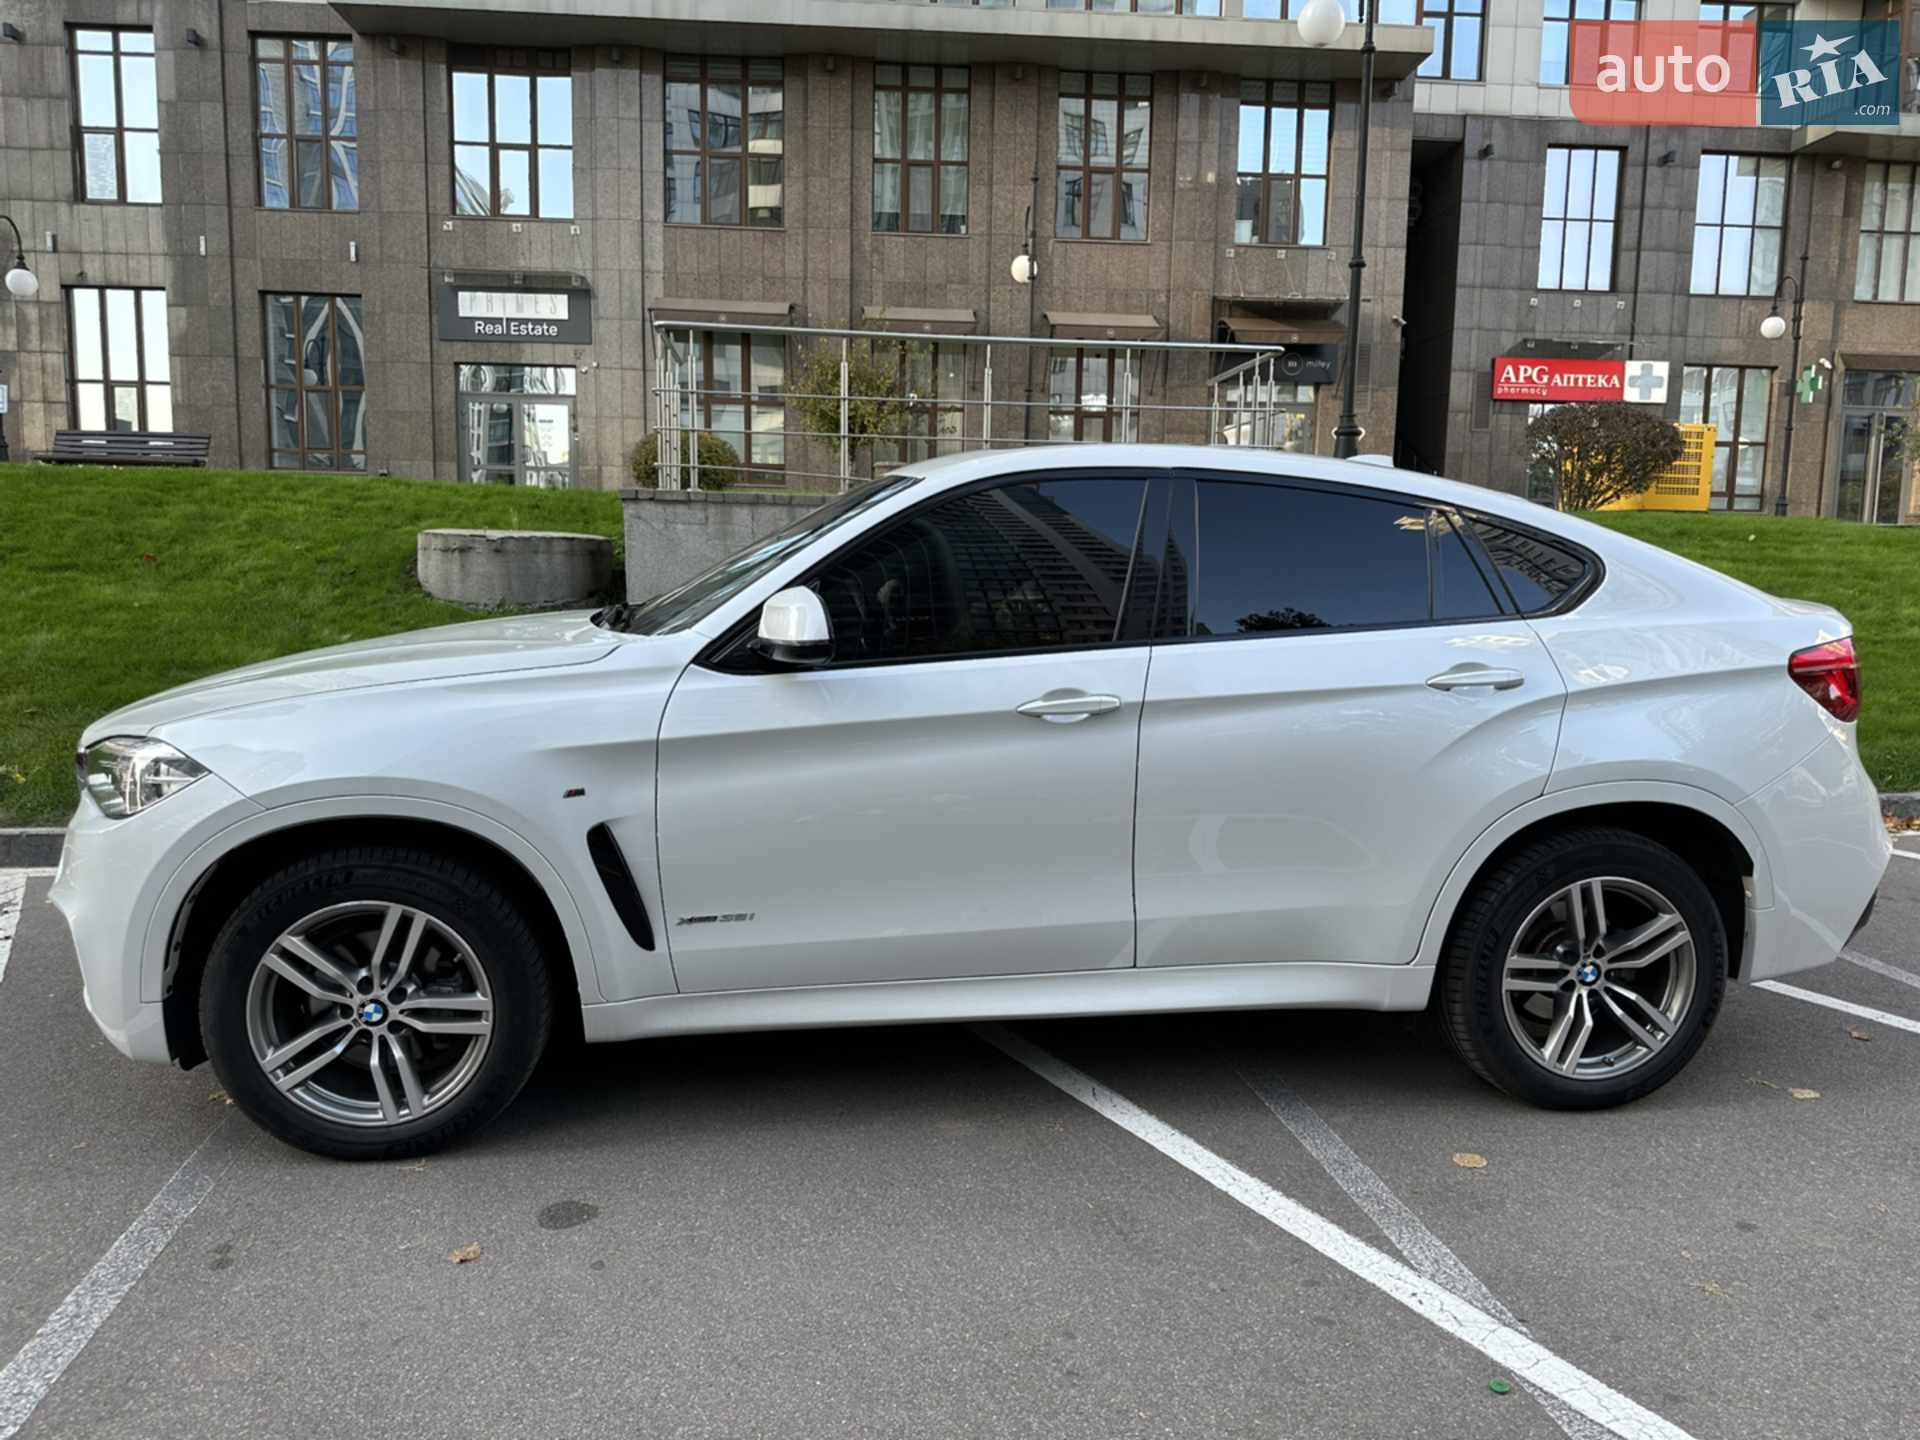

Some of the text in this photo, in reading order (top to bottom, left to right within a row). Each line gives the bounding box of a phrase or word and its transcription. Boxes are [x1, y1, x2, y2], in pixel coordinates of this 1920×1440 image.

[474, 319, 558, 336] Real Estate
[1500, 364, 1550, 384] APG
[1551, 372, 1621, 388] АПТЕКА
[1497, 386, 1547, 396] pharmacy
